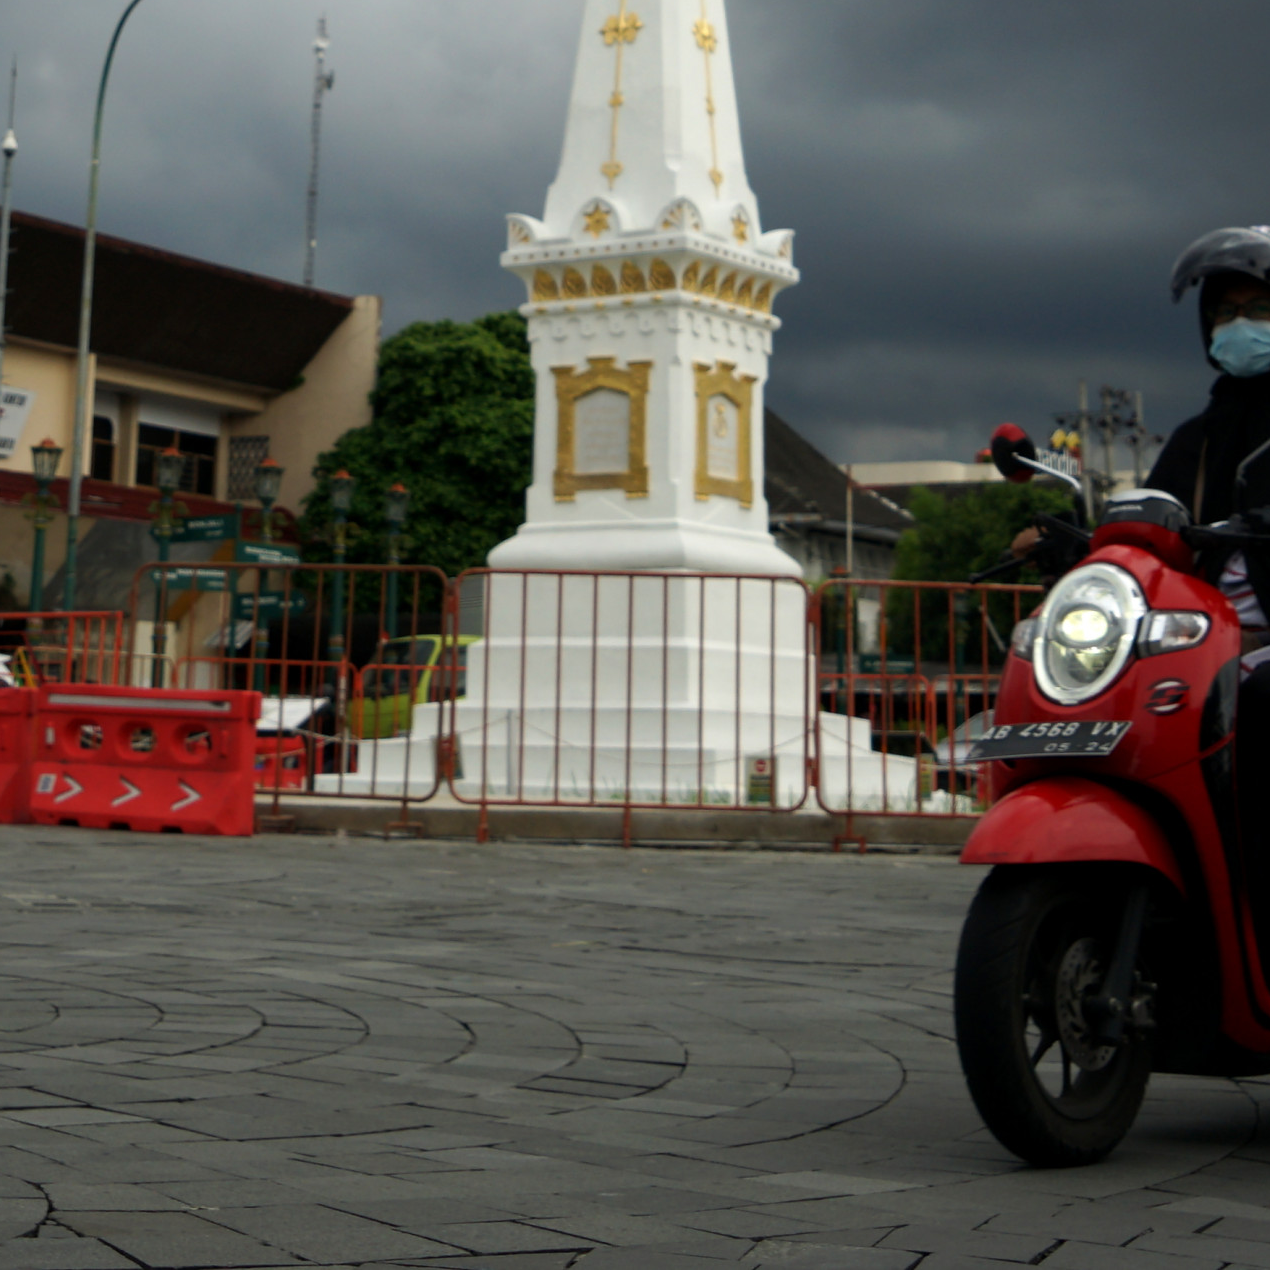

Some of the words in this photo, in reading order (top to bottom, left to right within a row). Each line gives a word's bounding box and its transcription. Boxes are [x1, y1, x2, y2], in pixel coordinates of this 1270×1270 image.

[980, 725, 1014, 741] AB
[1018, 722, 1081, 738] 4568
[1091, 721, 1122, 736] VX
[1043, 742, 1072, 752] 05
